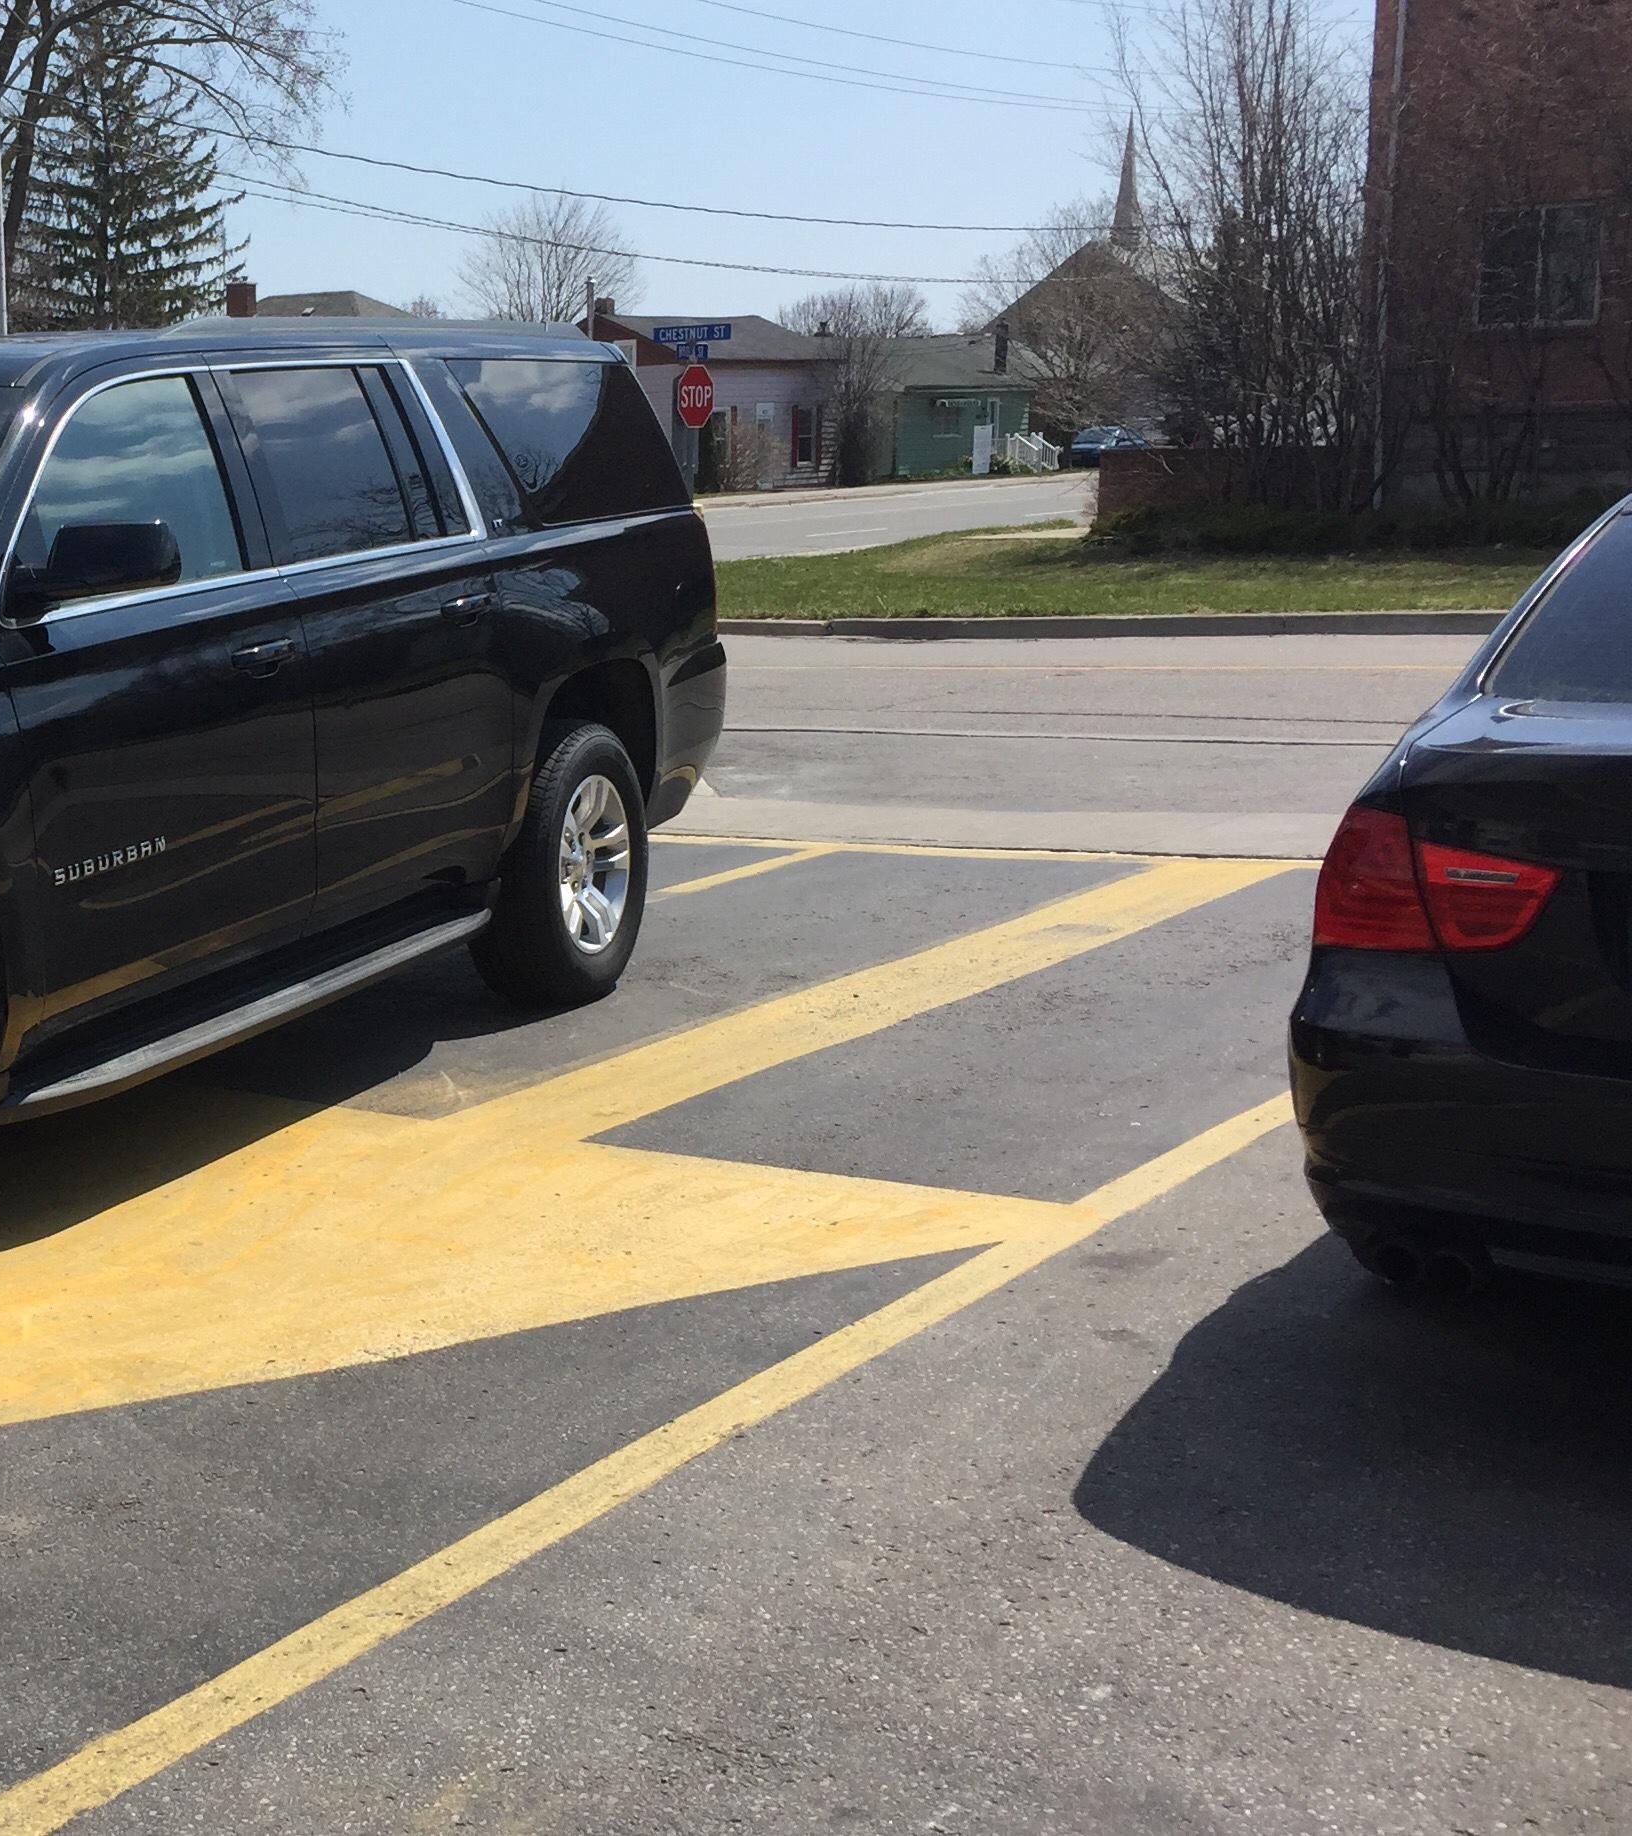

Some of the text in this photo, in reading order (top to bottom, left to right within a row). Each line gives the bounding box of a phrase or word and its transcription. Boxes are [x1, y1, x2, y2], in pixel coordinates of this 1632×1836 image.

[659, 326, 726, 341] CHESTNUT ST
[680, 385, 712, 408] STOP
[53, 835, 167, 887] SUBURBAN
